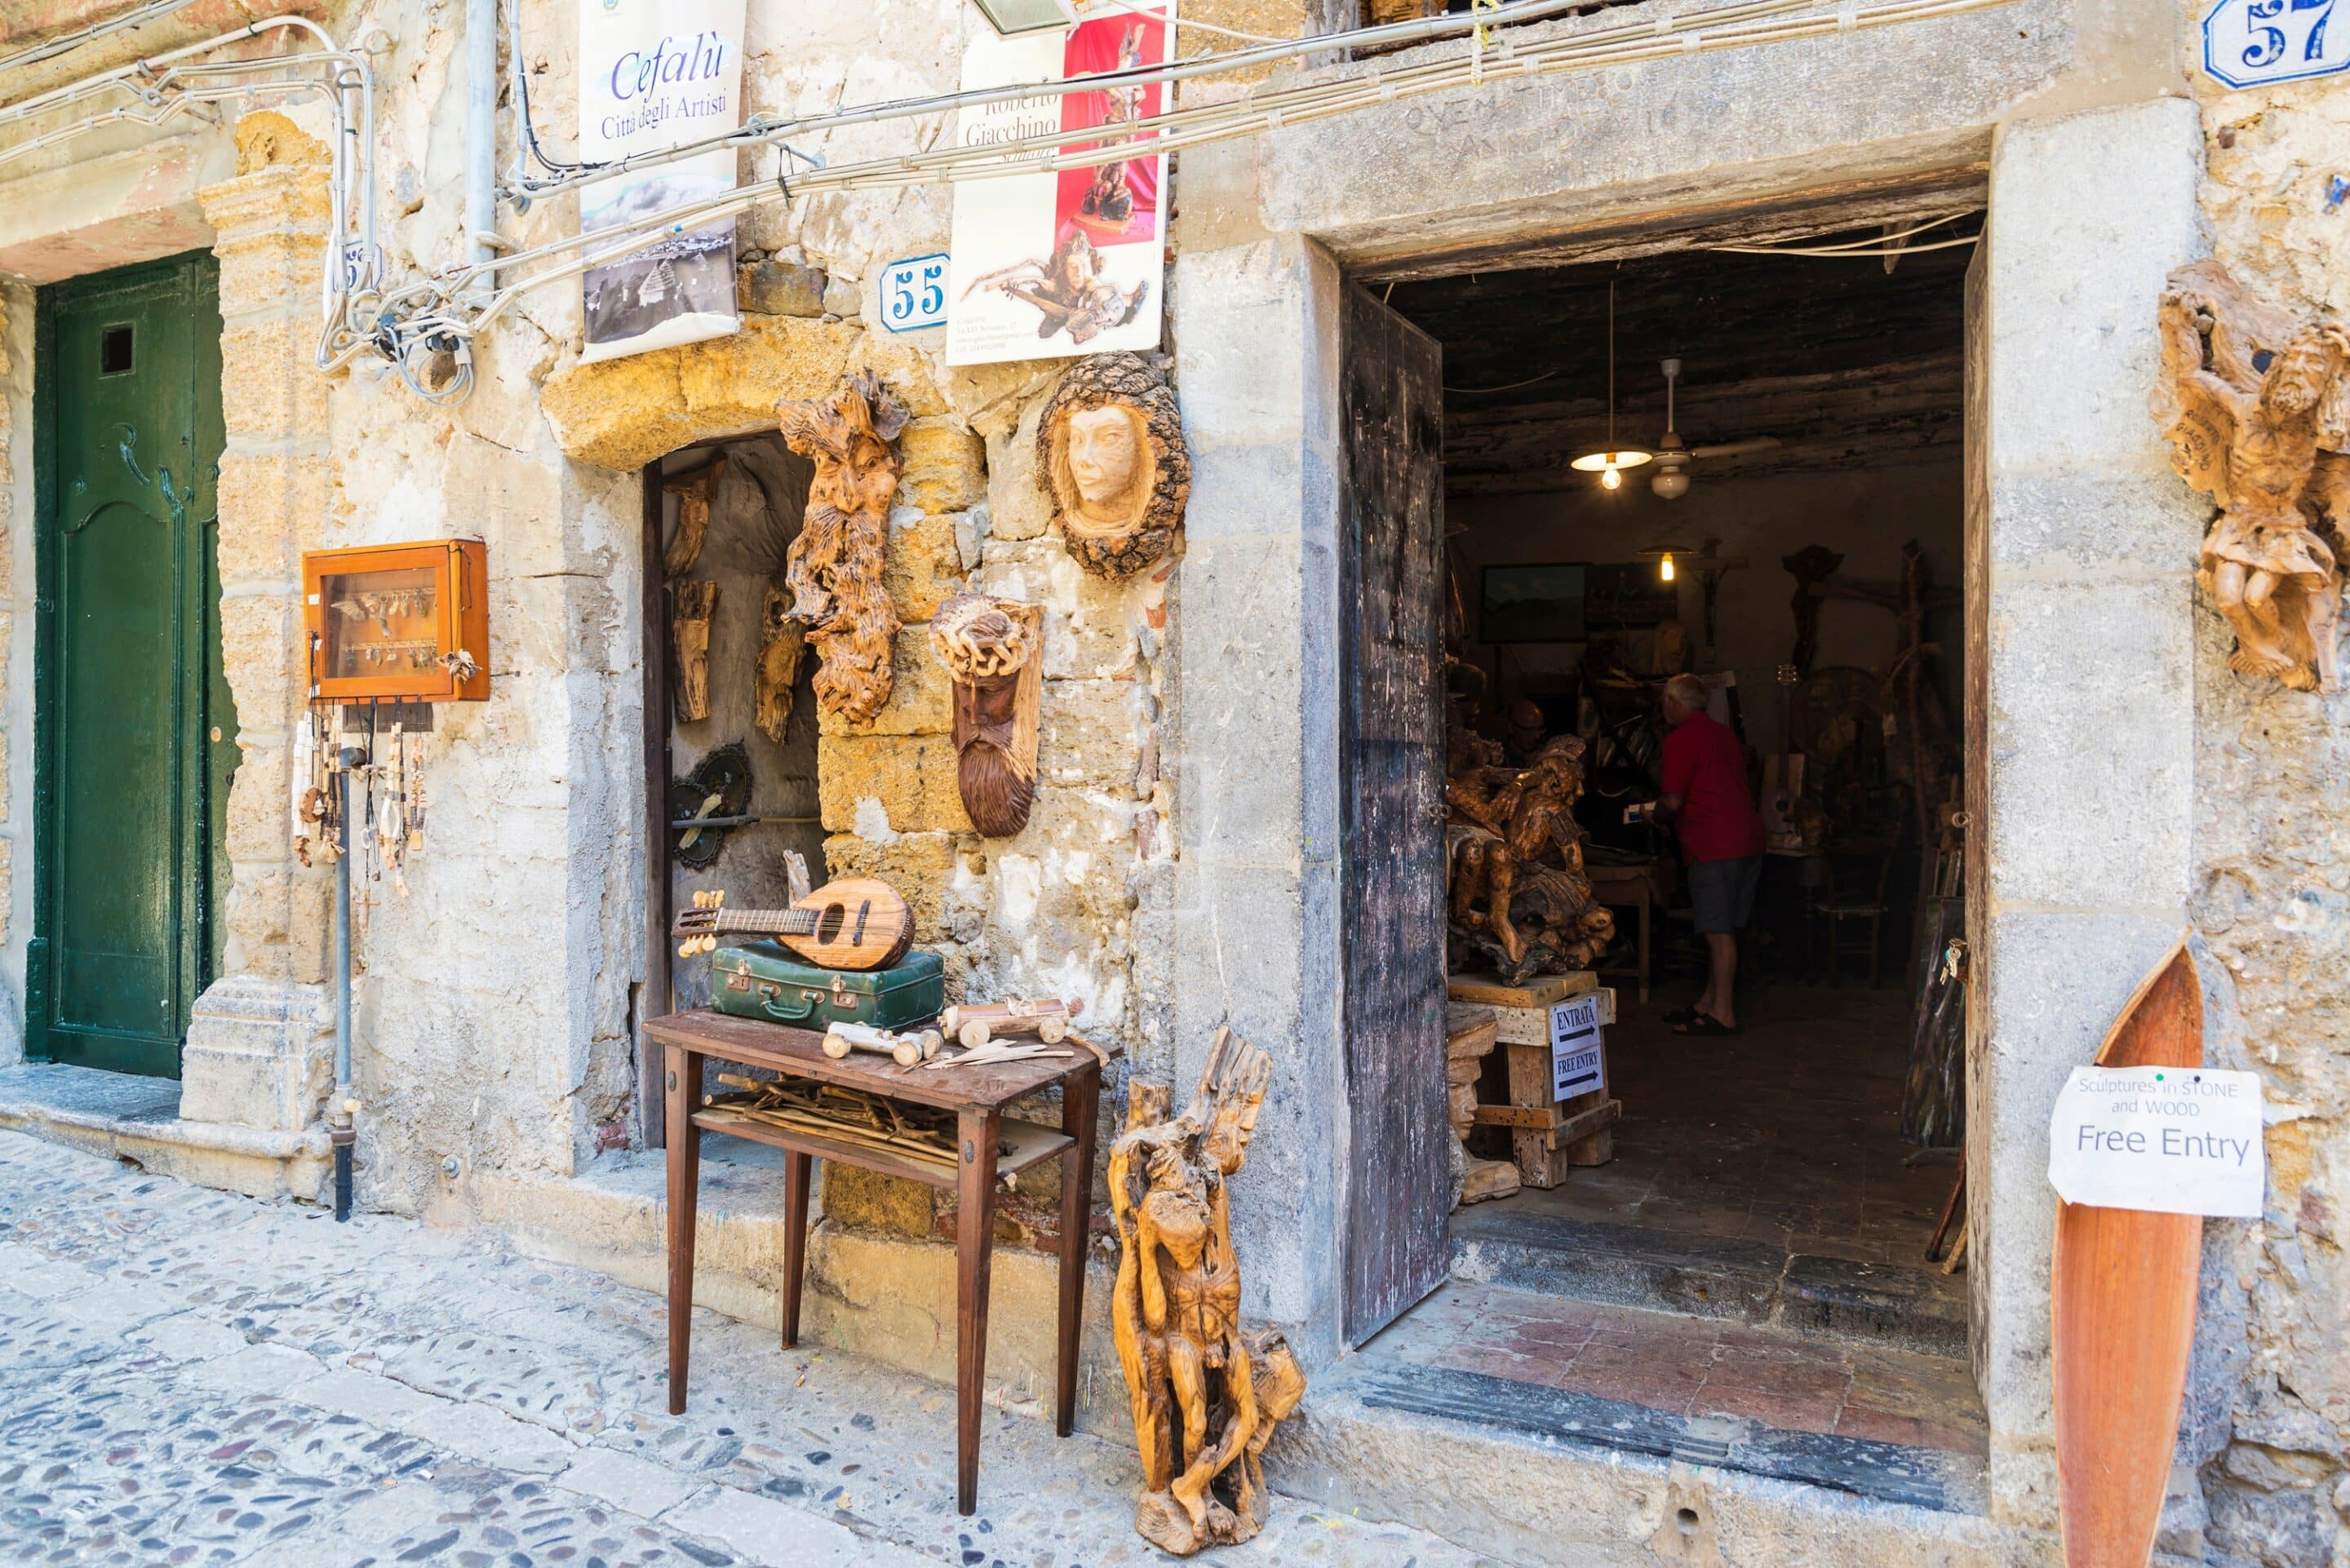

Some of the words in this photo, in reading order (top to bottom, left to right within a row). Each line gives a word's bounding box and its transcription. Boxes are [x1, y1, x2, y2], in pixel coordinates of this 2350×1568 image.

[2241, 0, 2336, 67] 57
[611, 30, 724, 104] Cefalù
[601, 111, 636, 140] Città
[639, 98, 671, 129] degli
[675, 87, 727, 118] Artisti
[966, 115, 1057, 146] Giacchino
[893, 265, 943, 319] 55
[1556, 1005, 1595, 1030] ENTRATA
[1558, 1056, 1576, 1075] FREE
[1576, 1051, 1598, 1070] ENTRY
[2079, 1078, 2157, 1095] Sculptures
[2163, 1079, 2177, 1096] in
[2182, 1081, 2239, 1098] STONE
[2111, 1099, 2138, 1114] and
[2145, 1100, 2201, 1117] WOOD
[2077, 1124, 2146, 1154] Free
[2162, 1127, 2250, 1167] Entry
